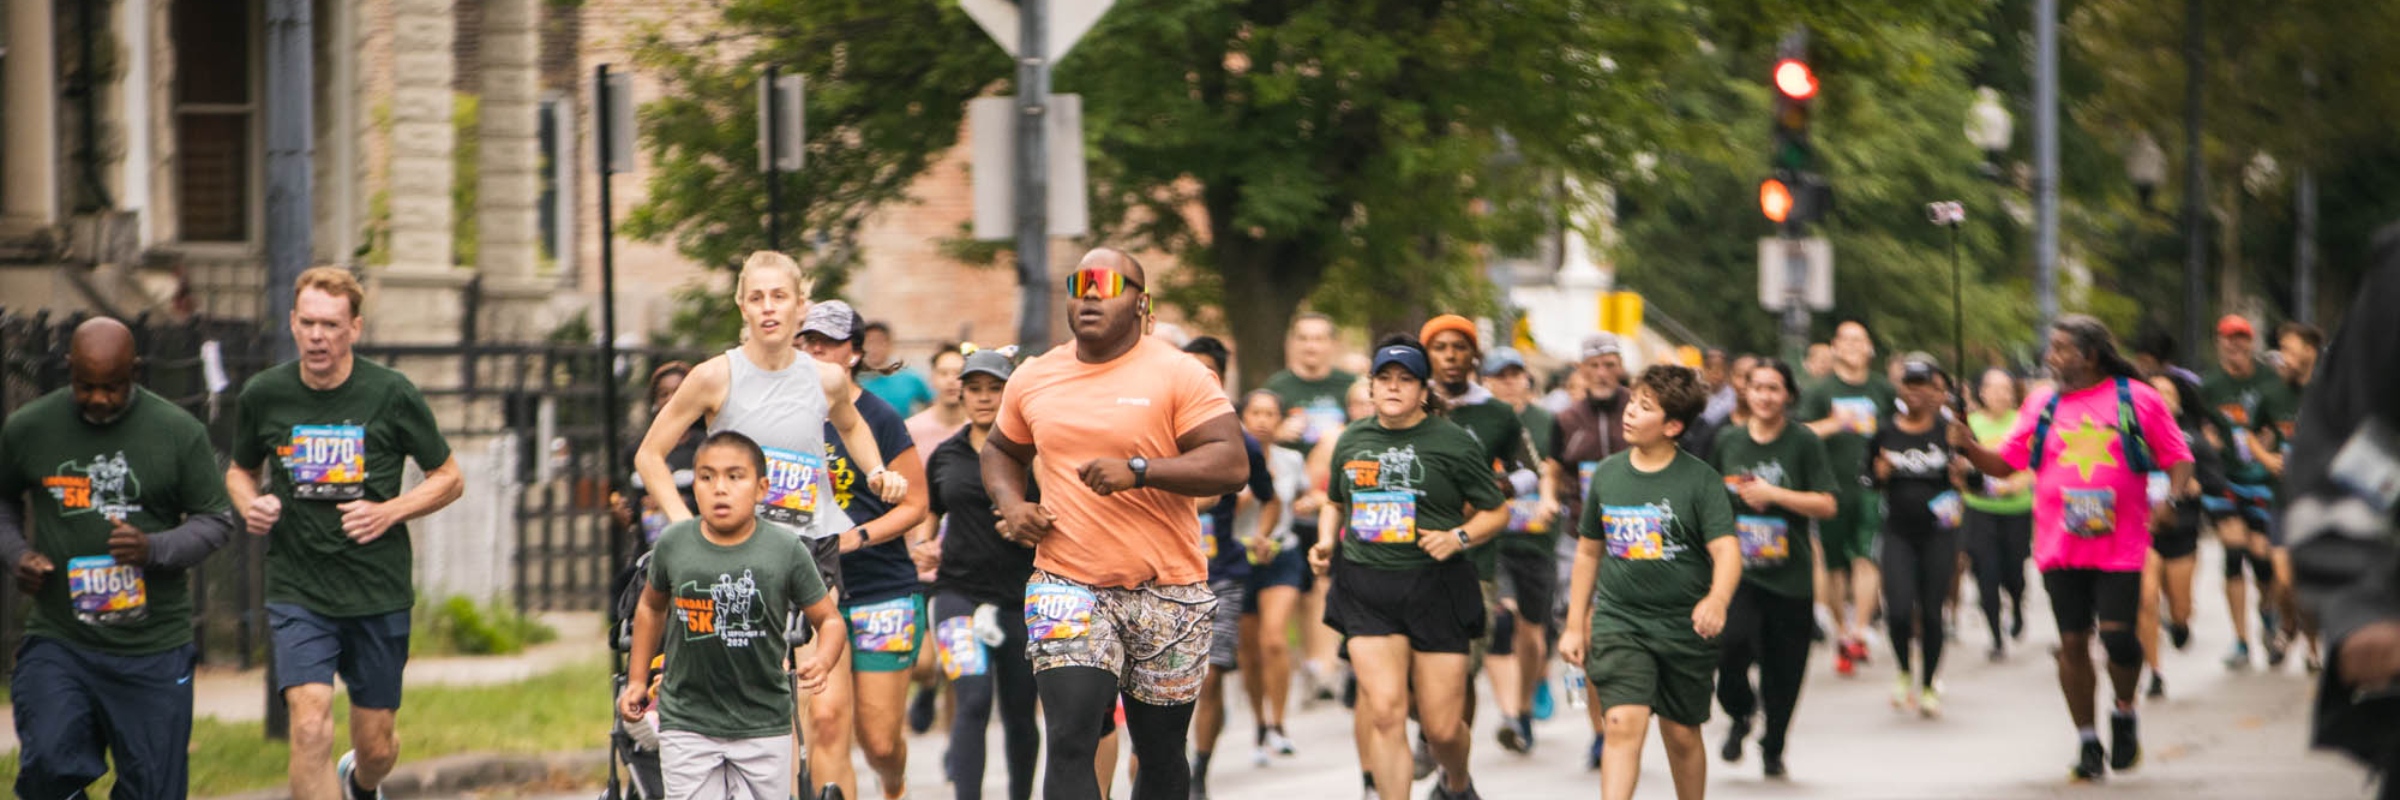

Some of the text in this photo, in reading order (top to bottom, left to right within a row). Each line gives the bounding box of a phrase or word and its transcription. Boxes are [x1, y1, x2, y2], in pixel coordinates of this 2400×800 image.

[304, 437, 354, 464] 1070
[766, 459, 812, 491] 1189
[63, 487, 91, 508] 5K
[1365, 502, 1401, 526] 578
[1612, 516, 1647, 542] 233
[83, 565, 135, 594] 1060
[1037, 594, 1078, 620] 809
[688, 610, 715, 633] 5K
[726, 638, 749, 647] 2024
